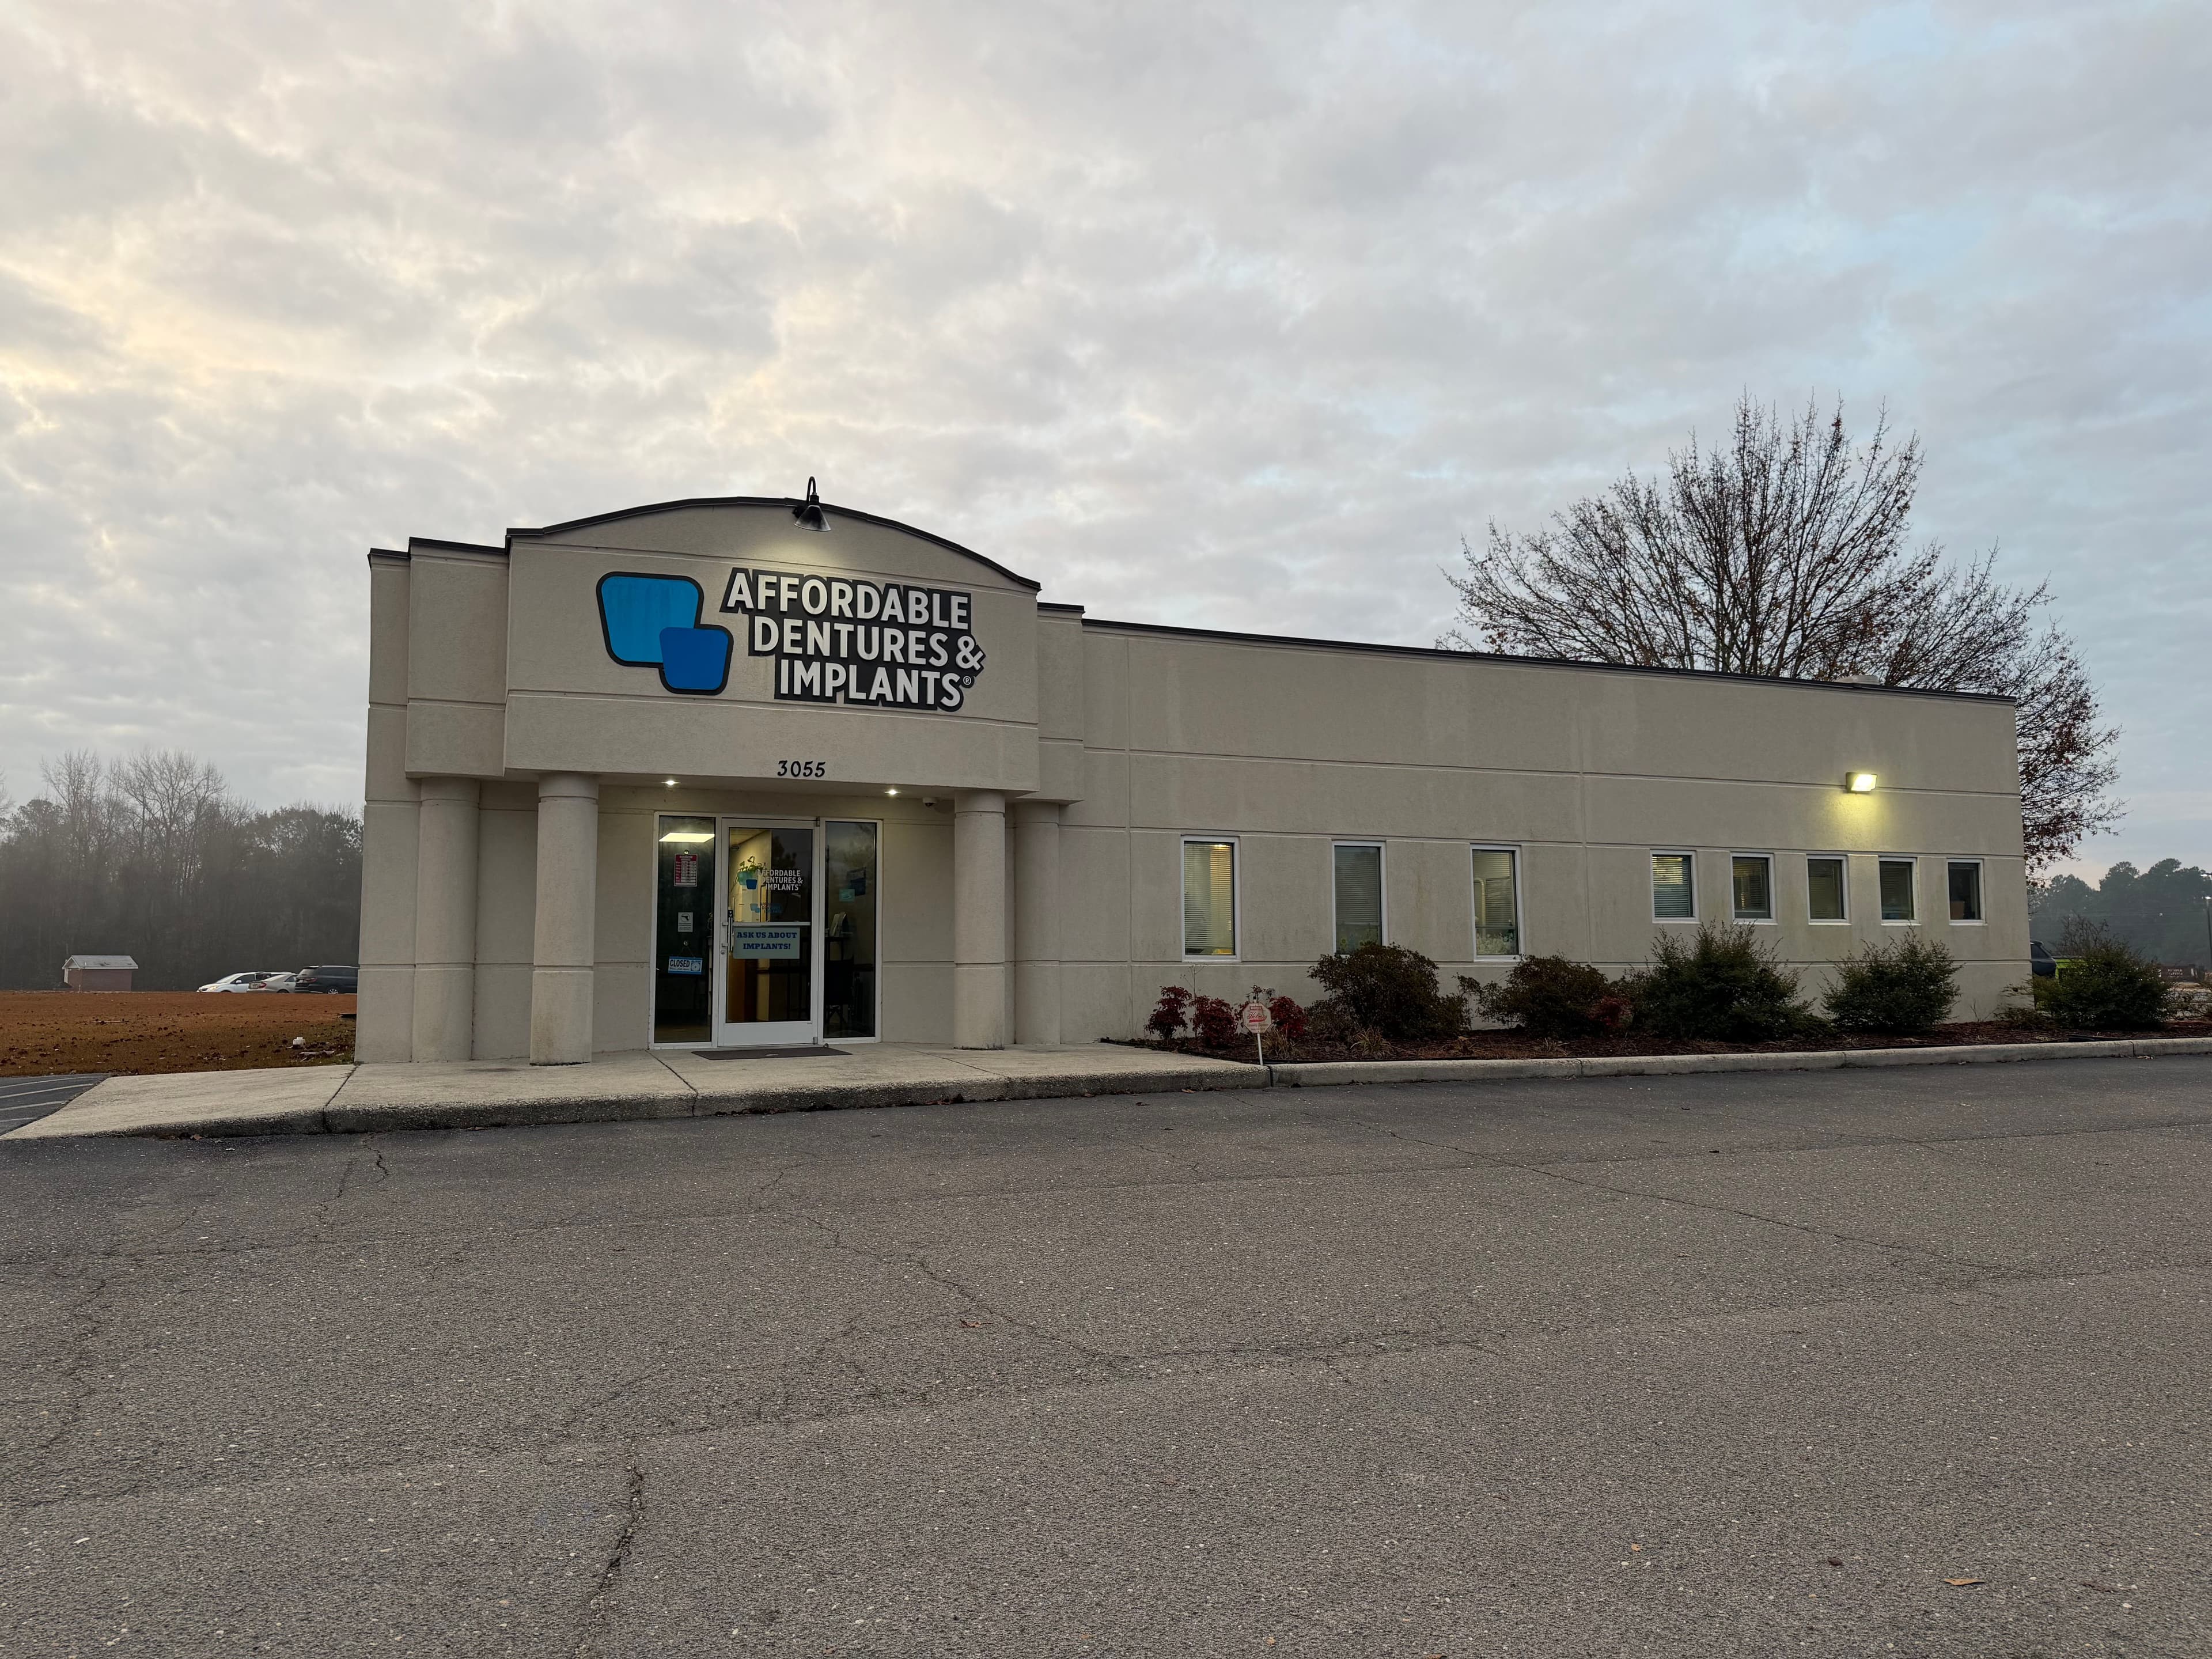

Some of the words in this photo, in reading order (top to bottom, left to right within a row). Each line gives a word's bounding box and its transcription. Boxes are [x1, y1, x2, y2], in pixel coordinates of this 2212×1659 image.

[727, 573, 968, 630] AFFORDABLE
[755, 616, 948, 666] DENTURES
[956, 635, 983, 671] &
[777, 760, 825, 778] 3055
[670, 959, 690, 968] CLOSED
